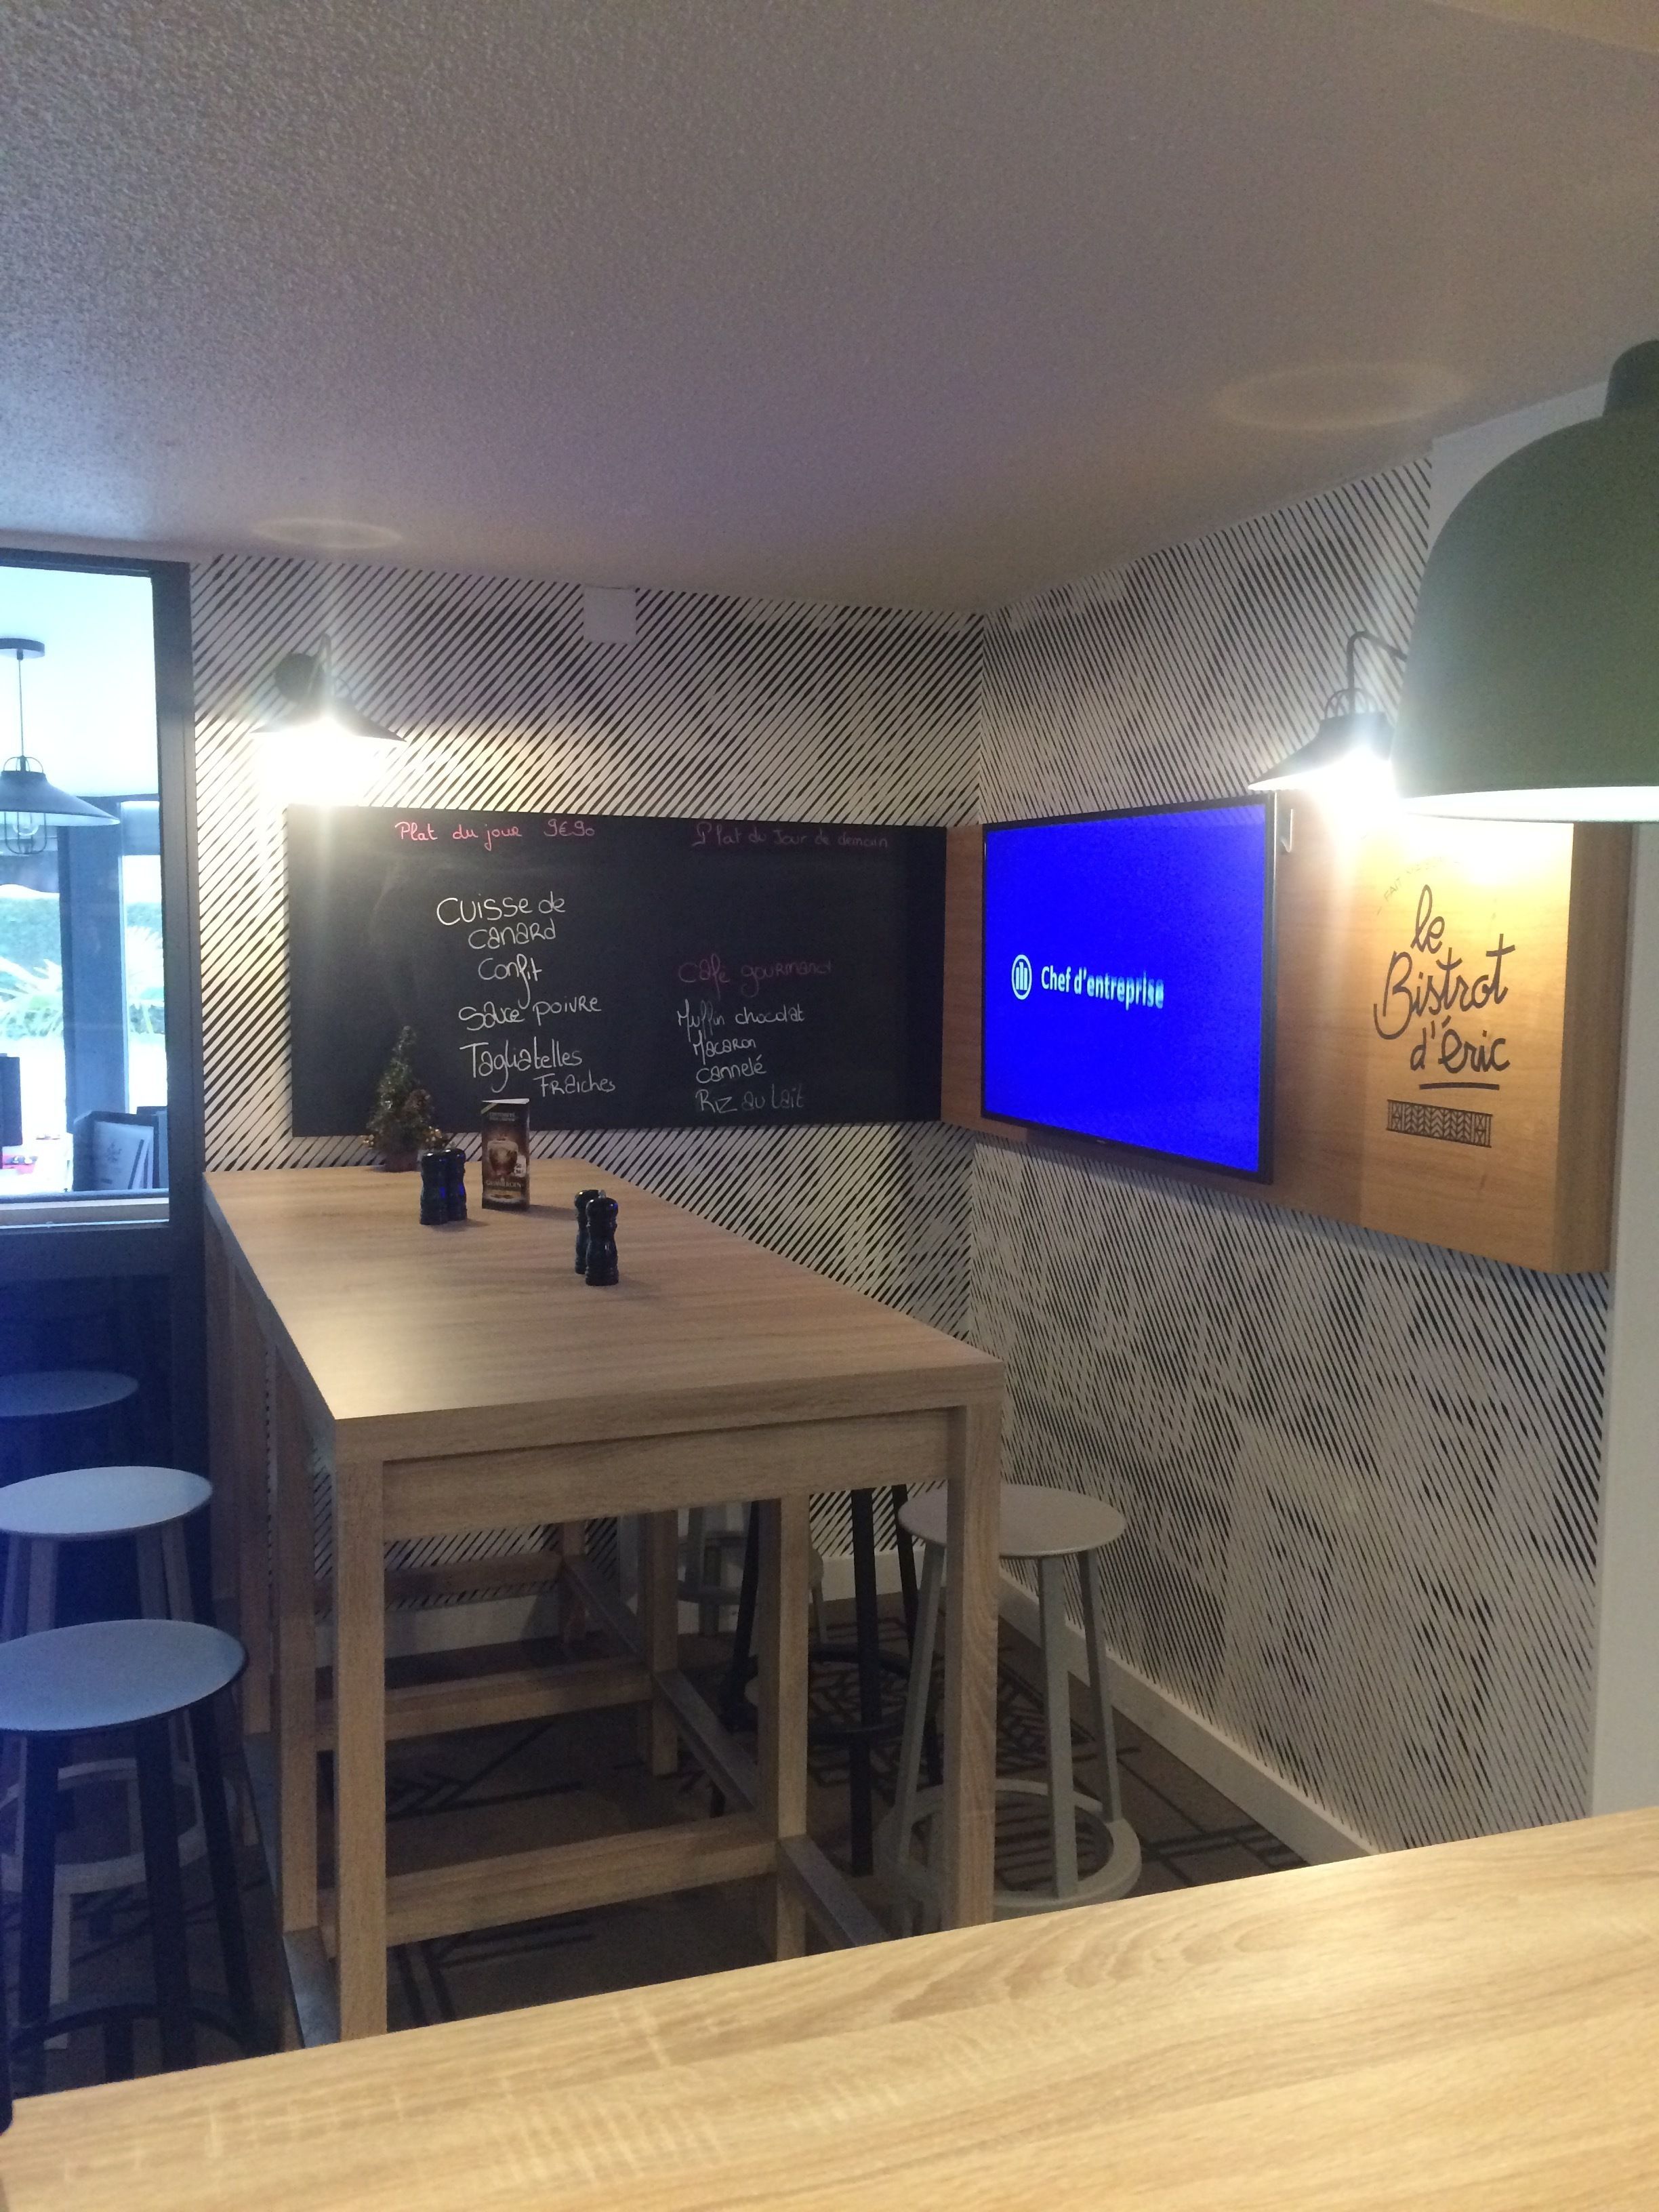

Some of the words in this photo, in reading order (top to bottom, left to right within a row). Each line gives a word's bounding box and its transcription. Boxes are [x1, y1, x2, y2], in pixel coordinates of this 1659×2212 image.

[394, 821, 438, 841] Plat
[452, 824, 478, 840] du
[480, 823, 523, 851] jour
[748, 825, 766, 844] du
[815, 827, 830, 846] de
[538, 890, 566, 914] de
[1410, 884, 1446, 954] le
[1041, 965, 1071, 993] Chef
[1073, 966, 1164, 1011] d'entreprise
[1373, 933, 1515, 1040] Bistrot
[532, 996, 602, 1026] poivre
[459, 1036, 583, 1093] Tagliatelles
[695, 1088, 738, 1114] Riz
[741, 1091, 766, 1111] au
